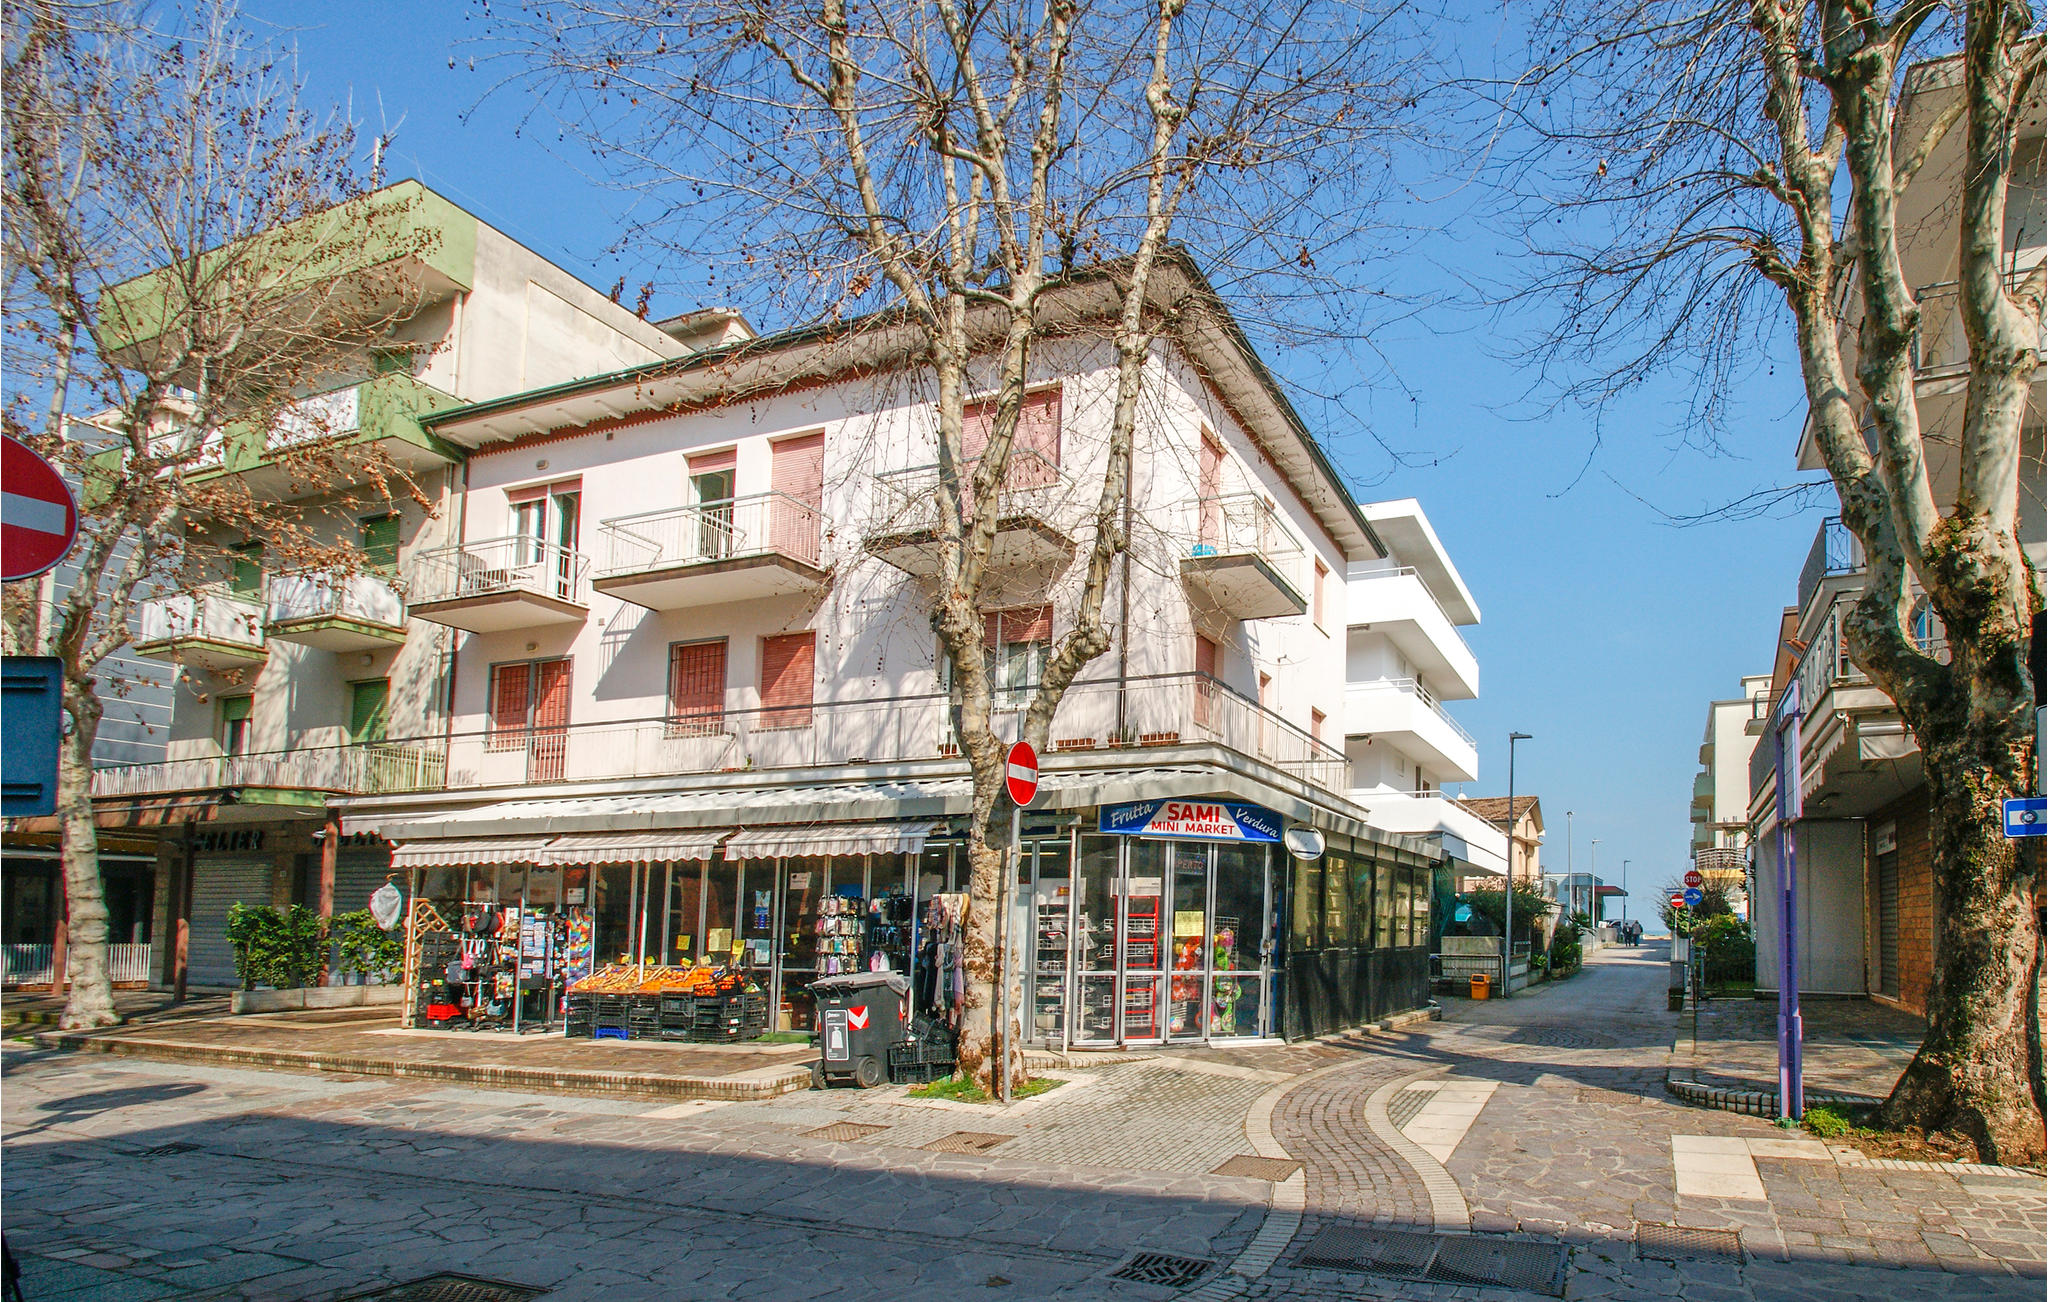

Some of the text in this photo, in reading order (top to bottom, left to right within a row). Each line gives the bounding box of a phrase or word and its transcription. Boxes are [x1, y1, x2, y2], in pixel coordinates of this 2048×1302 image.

[1110, 802, 1154, 828] Frutta
[1167, 803, 1220, 823] SAMI
[1235, 808, 1279, 838] Verdura
[1151, 820, 1235, 835] MINI MARKET
[1685, 875, 1701, 883] STOP
